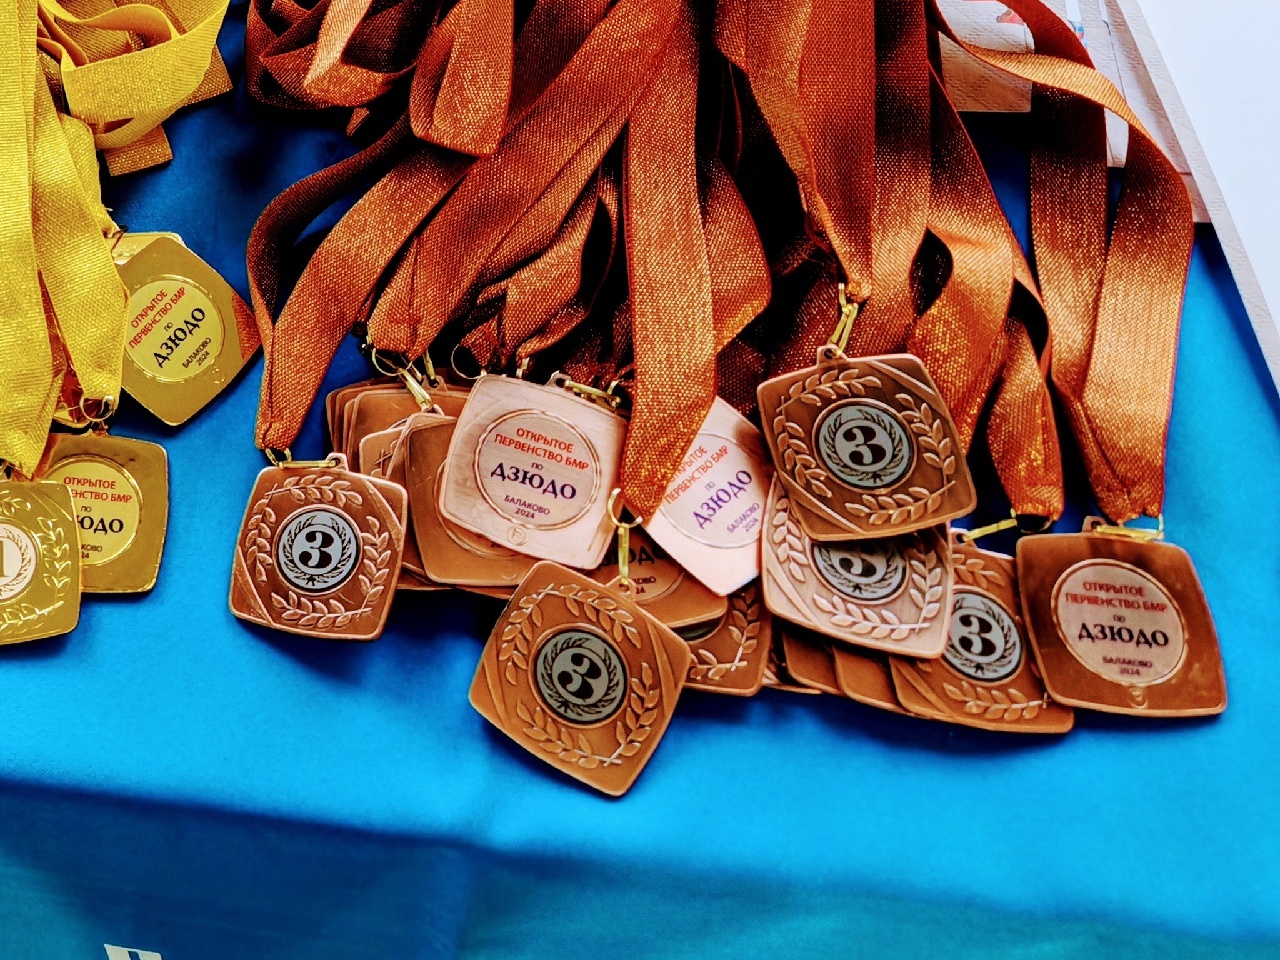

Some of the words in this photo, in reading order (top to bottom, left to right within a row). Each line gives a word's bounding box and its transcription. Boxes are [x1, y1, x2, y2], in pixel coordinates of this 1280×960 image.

[128, 302, 173, 349] ПЕРВЕНСТВО
[170, 287, 186, 304] БМР
[131, 289, 168, 328] ОТКРЫТОЕ
[153, 307, 205, 368] ДЗЮДО
[182, 337, 212, 368] БАЛАКОВО
[195, 350, 210, 366] 2024
[494, 433, 563, 463] ПЕРВЕНСТВО
[565, 456, 590, 471] БМР
[516, 427, 575, 453] ОТКРЫТОЕ
[841, 424, 888, 466] 3
[63, 476, 116, 490] ОТКРЫТОЕ
[110, 493, 132, 503] БМР
[490, 462, 577, 500] ДЗЮДО
[664, 459, 713, 505] ПЕРВЕНСТВО
[693, 470, 753, 530] ДЗЮДО
[503, 494, 551, 515] БАЛАКОВО
[515, 507, 535, 519] 2024
[299, 530, 335, 569] 3
[959, 613, 999, 658] 3
[1078, 622, 1169, 649] ДЗЮДО
[555, 646, 601, 700] 3
